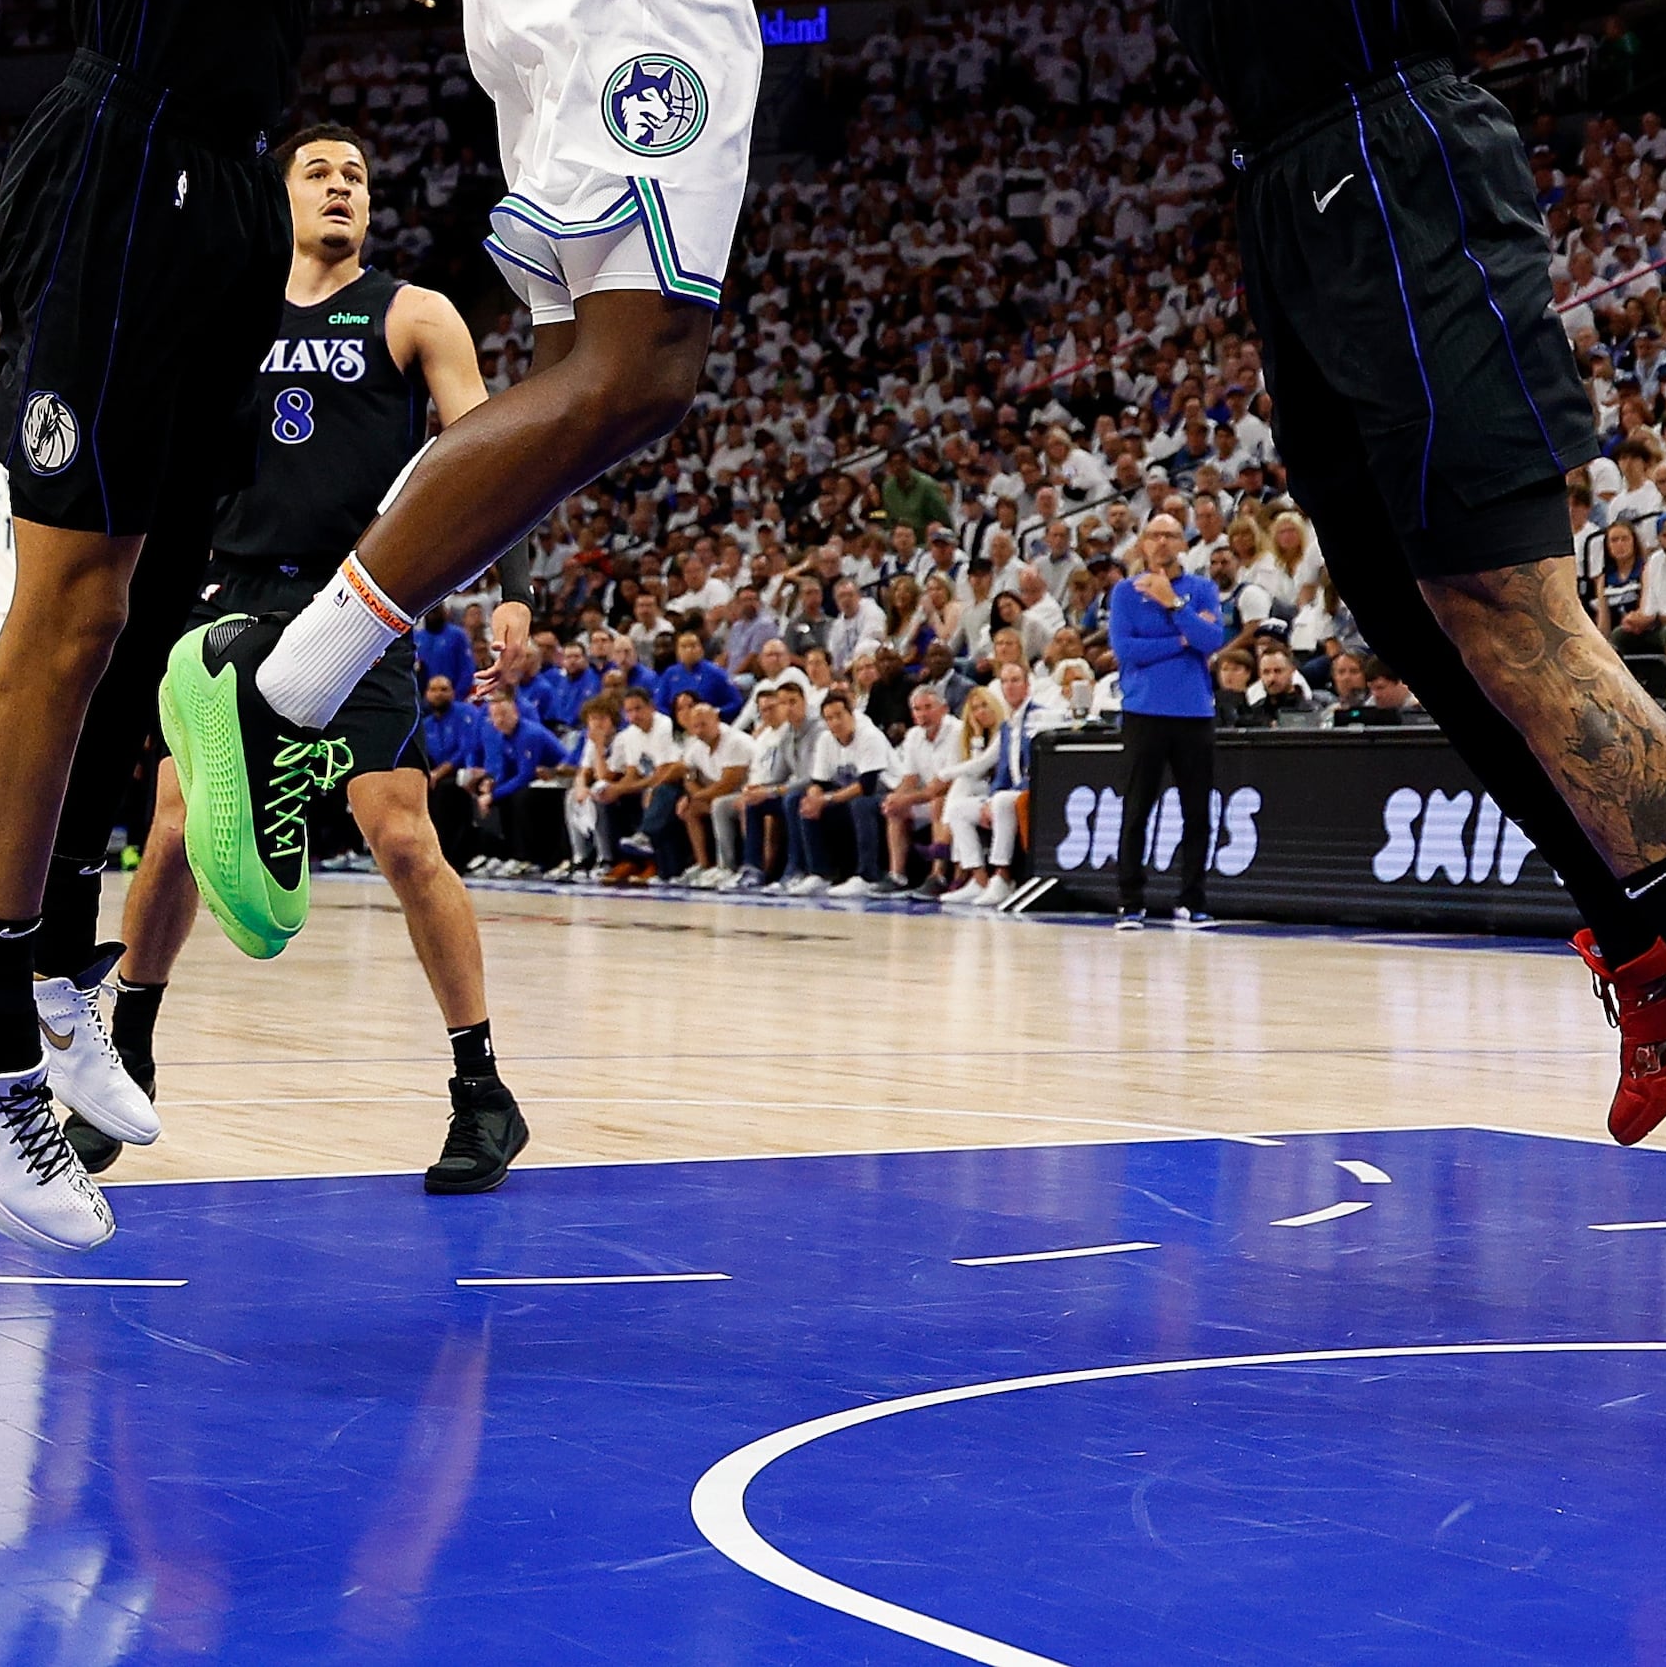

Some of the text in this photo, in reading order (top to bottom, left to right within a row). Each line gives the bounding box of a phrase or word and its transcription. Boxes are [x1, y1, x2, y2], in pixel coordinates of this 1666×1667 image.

[328, 313, 370, 326] chime
[272, 387, 314, 445] 8
[1372, 786, 1565, 886] SKI
